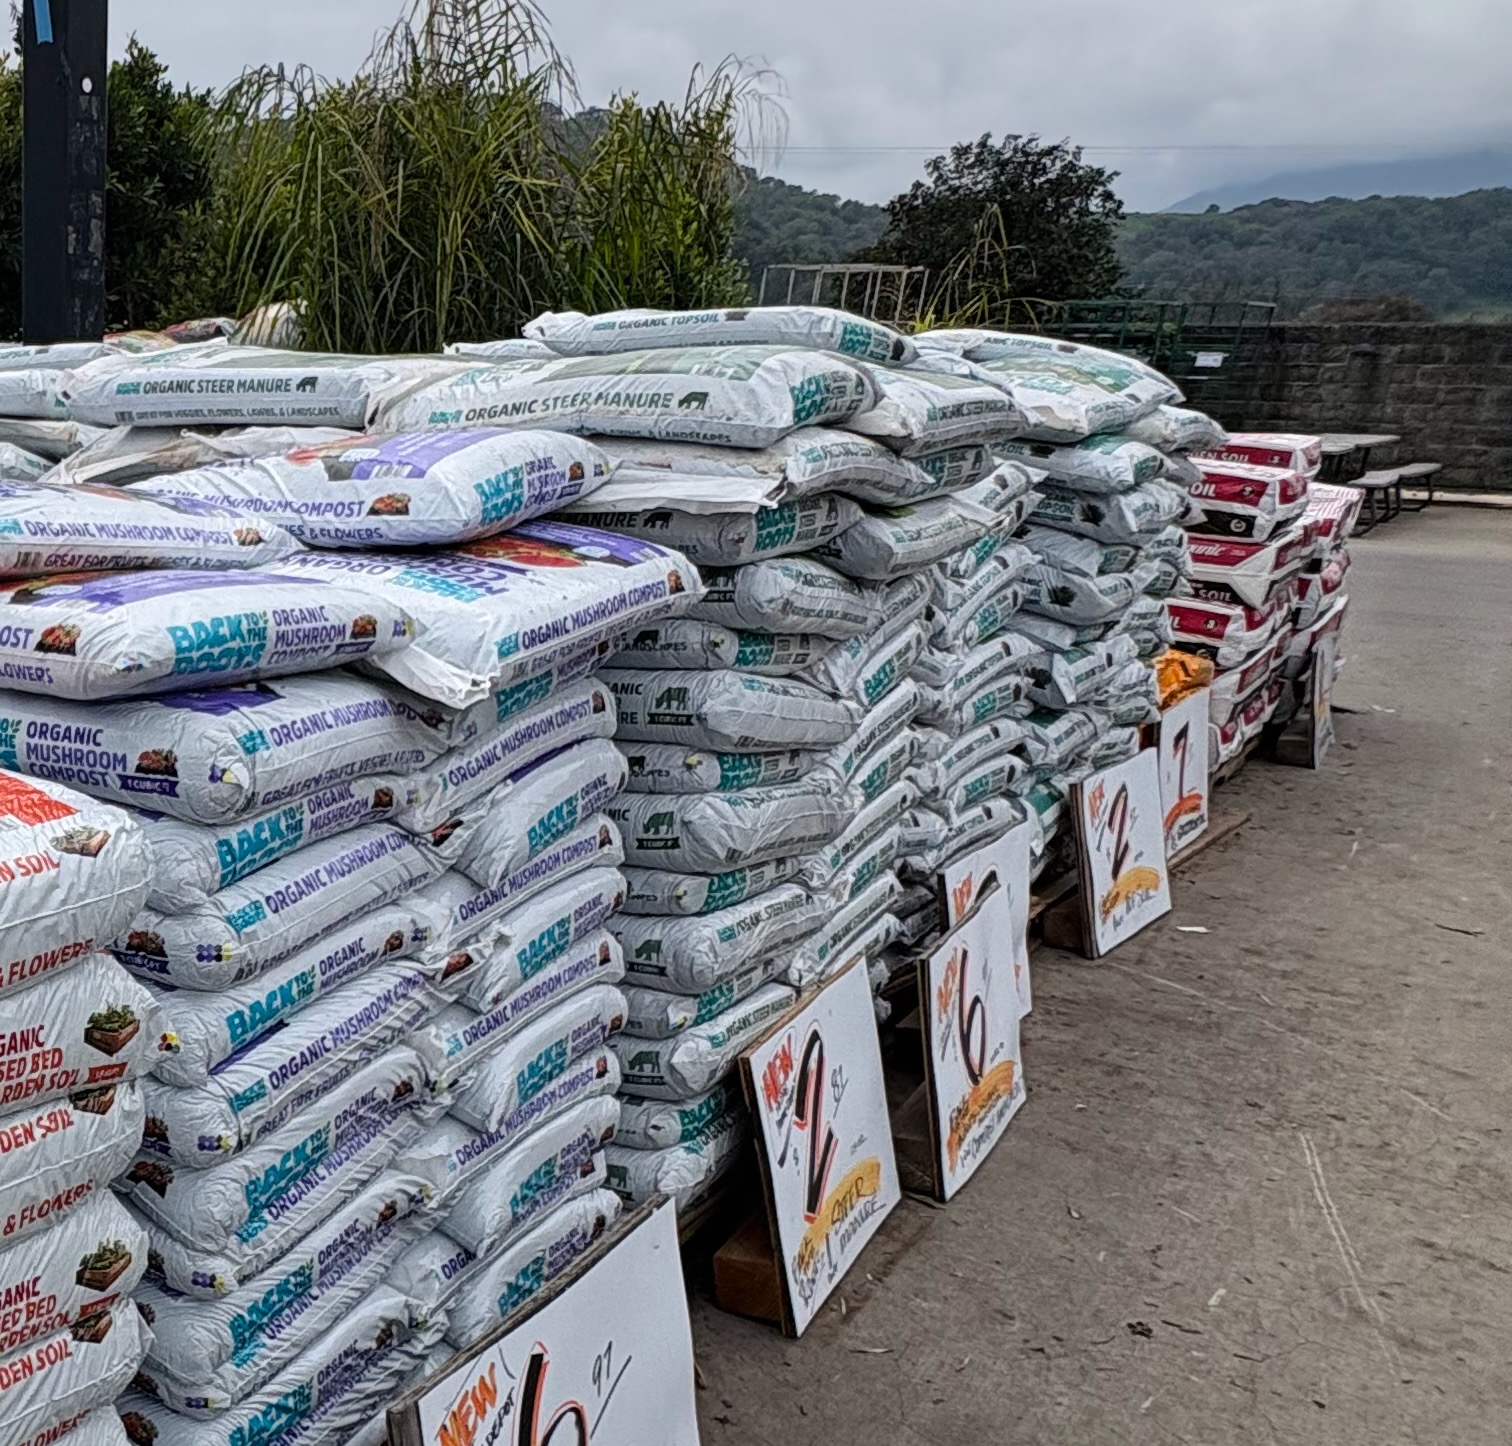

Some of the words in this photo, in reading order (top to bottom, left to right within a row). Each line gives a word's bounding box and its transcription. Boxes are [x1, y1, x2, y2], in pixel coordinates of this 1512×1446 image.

[143, 379, 195, 395] ORGANIC
[197, 378, 234, 394] STEER
[238, 378, 291, 394] MANURE
[464, 400, 538, 422] ORGANIC
[595, 392, 674, 411] MANURE
[522, 618, 570, 650] ORGANIC
[571, 593, 627, 629] MUSHROOM
[629, 580, 666, 608] COMPOST
[1199, 590, 1232, 600] SOIL
[26, 722, 103, 746] ORGANIC
[449, 744, 502, 787] ORGANIC
[501, 715, 554, 757] MUSHROOM
[555, 700, 591, 728] COMPOST
[26, 745, 127, 770] MUSHROOM
[18, 851, 60, 877] SOIL
[458, 885, 507, 921] ORGANIC
[508, 853, 561, 896] MUSHROOM
[562, 835, 598, 863] COMPOST
[265, 869, 327, 914] ORGANIC
[8, 939, 94, 985] FLOWERS
[463, 1005, 511, 1047] ORGANIC
[511, 973, 562, 1015] MUSHROOM
[563, 953, 598, 985] COMPOST
[959, 949, 985, 1086] 6
[269, 1035, 331, 1090] ORGANIC
[557, 1068, 594, 1099] COMPOST
[795, 1029, 834, 1214] 2
[36, 1339, 73, 1373] SOIL
